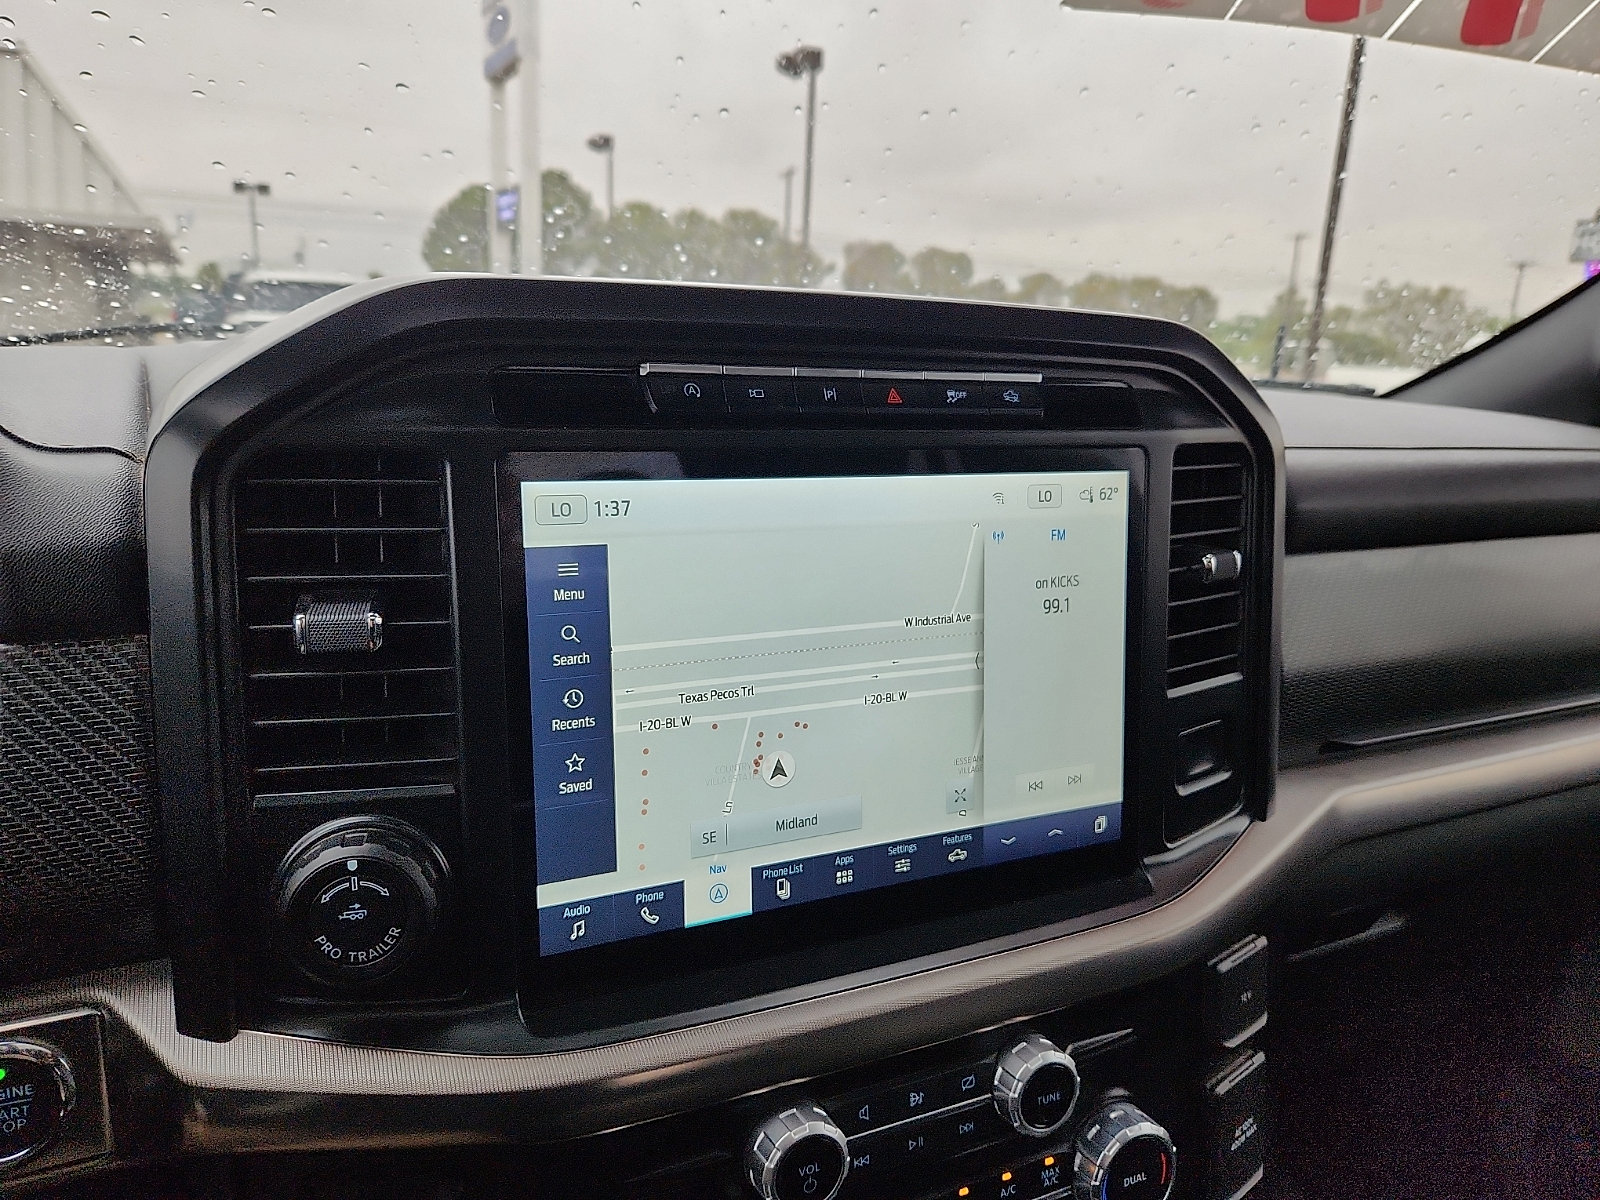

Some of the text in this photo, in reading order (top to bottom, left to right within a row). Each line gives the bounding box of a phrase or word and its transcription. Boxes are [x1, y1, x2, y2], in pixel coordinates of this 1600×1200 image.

[1038, 490, 1052, 503] LO
[551, 503, 572, 518] LO
[594, 500, 631, 518] 1:37
[1051, 529, 1066, 541] FM
[1035, 574, 1080, 590] on KICKS
[553, 588, 585, 602] Menu
[1043, 597, 1070, 615] 99.1
[904, 612, 971, 628] W Industrial Ave
[552, 652, 591, 667] Search
[679, 685, 755, 704] Texas Pecos Trl
[899, 691, 908, 701] W
[551, 716, 596, 732] Recents
[681, 716, 692, 727] W
[558, 778, 593, 795] Saved
[702, 813, 818, 844] SE Midland
[942, 833, 973, 846] Features
[887, 842, 917, 856] Settings
[835, 855, 854, 866] Apps
[709, 864, 727, 875] Nav
[762, 863, 804, 880] Phone List
[636, 889, 665, 905] Phone
[563, 904, 592, 919] Audio
[314, 926, 402, 963] PRO TRAILER
[1037, 1090, 1062, 1106] TUNE
[798, 1162, 820, 1177] VOL
[1041, 1166, 1060, 1179] MAX
[1043, 1175, 1059, 1188] A/C
[1123, 1171, 1148, 1187] DUAL
[1000, 1184, 1017, 1198] A/C
